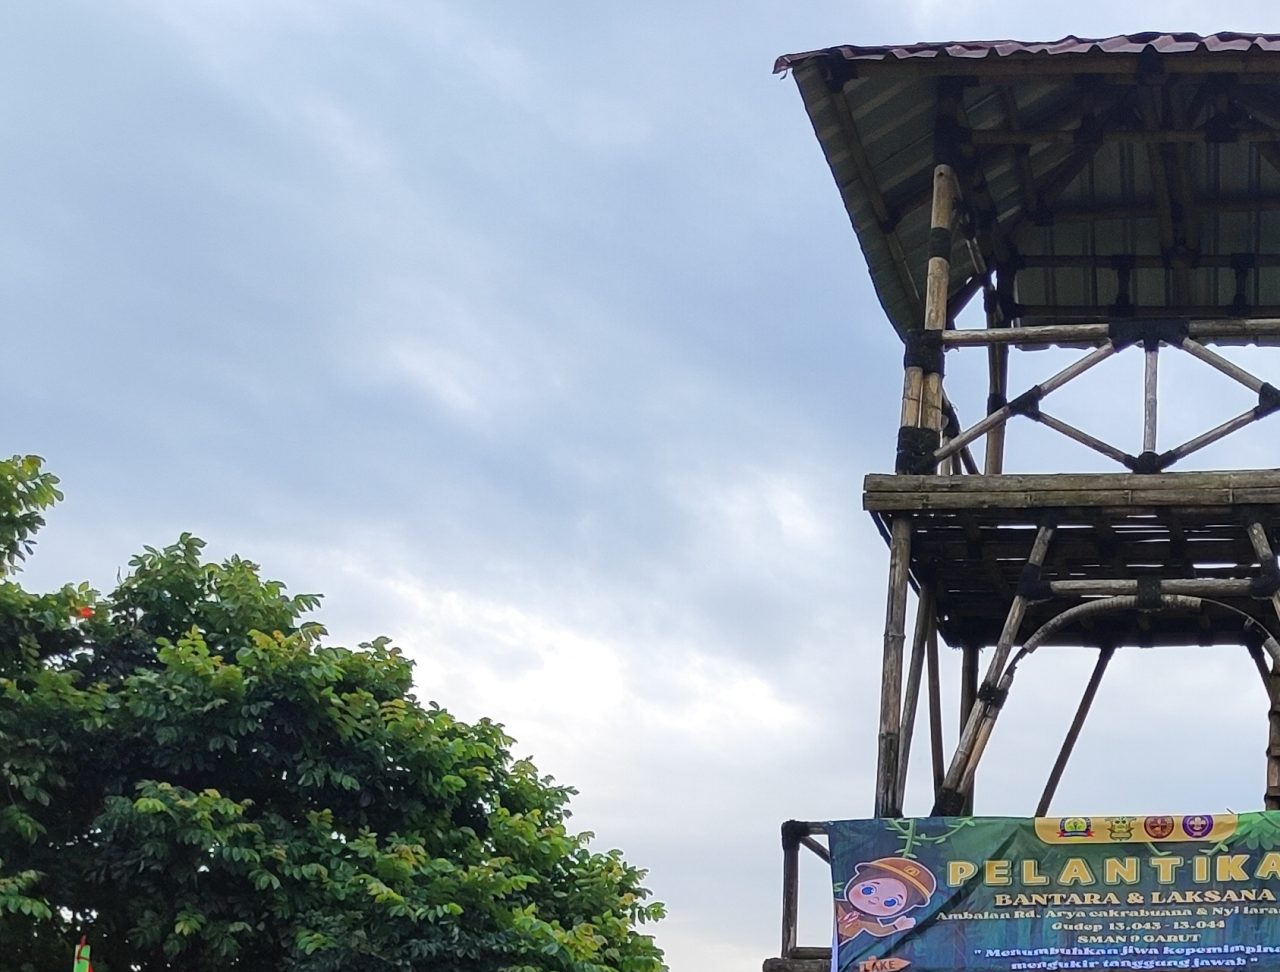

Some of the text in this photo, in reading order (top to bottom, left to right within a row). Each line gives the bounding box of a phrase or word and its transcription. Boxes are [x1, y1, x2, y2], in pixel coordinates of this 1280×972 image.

[995, 889, 1276, 906] BANTARA & LAKSANA
[936, 910, 1010, 920] Ambalan
[1045, 909, 1086, 919] Arya
[1196, 907, 1208, 916] &
[1052, 922, 1102, 932] Gudep
[1077, 935, 1126, 944] SMAN
[1143, 934, 1201, 943] GARUT
[863, 960, 896, 972] LAKE
[1011, 959, 1099, 970] mengukir
[1103, 957, 1190, 969] tanggung
